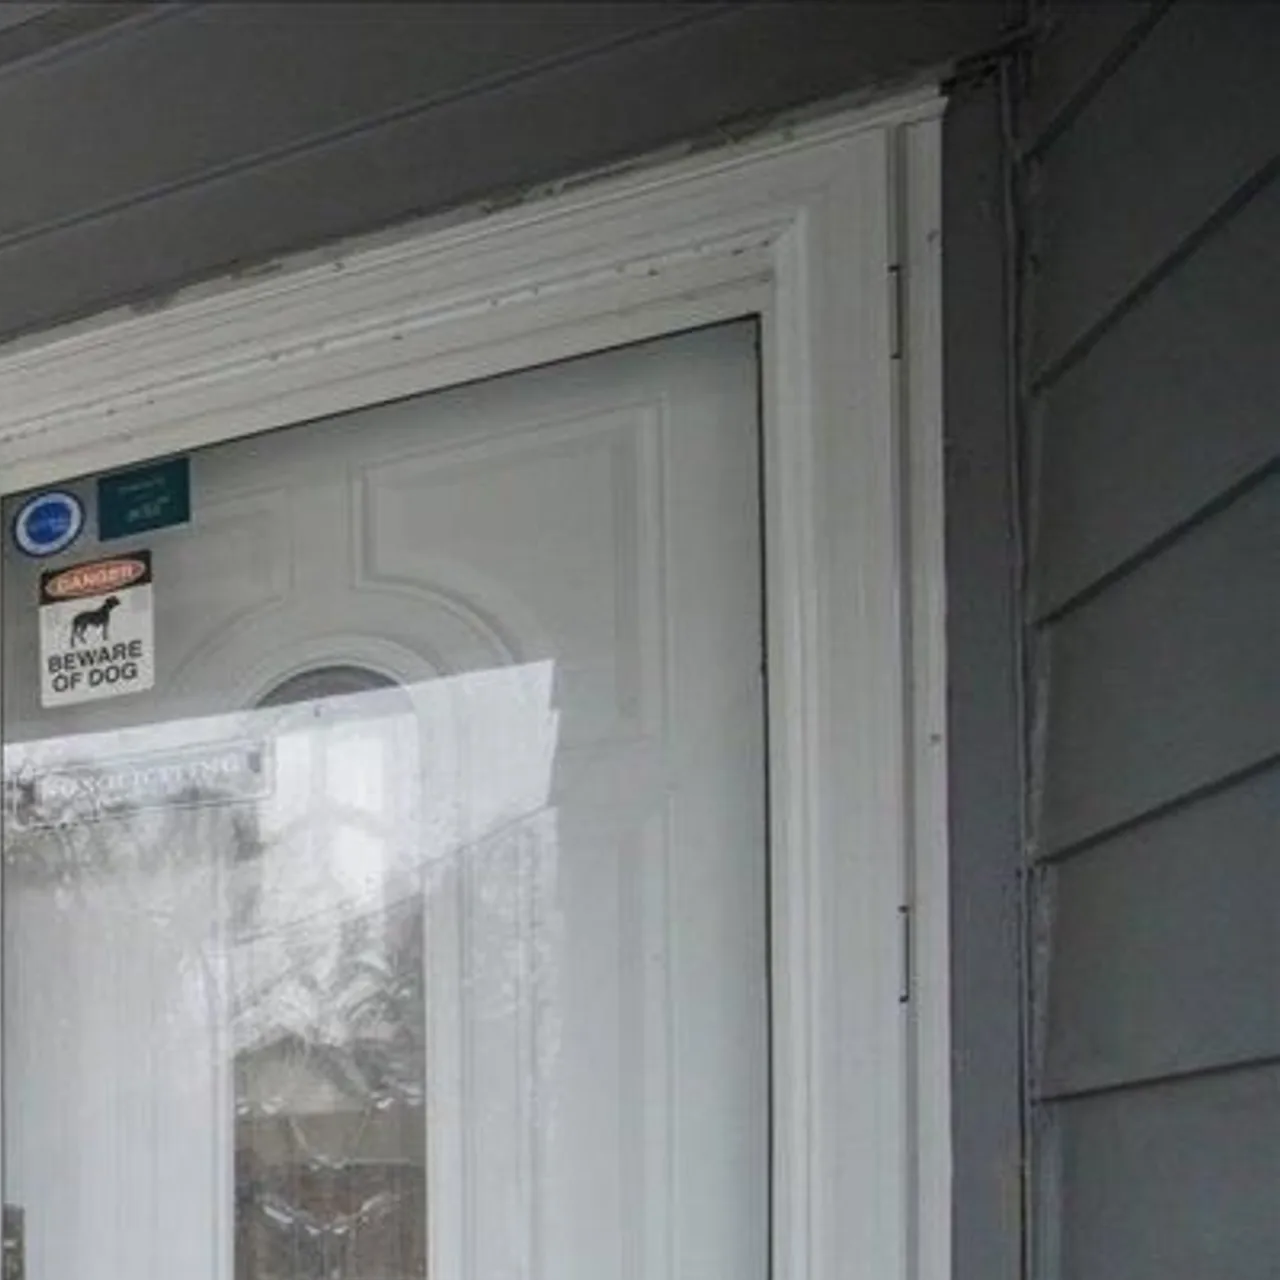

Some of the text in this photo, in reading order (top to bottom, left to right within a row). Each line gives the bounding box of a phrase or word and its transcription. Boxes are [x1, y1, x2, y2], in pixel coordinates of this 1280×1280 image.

[48, 640, 143, 674] BEWARE
[52, 662, 138, 692] OF DOG
